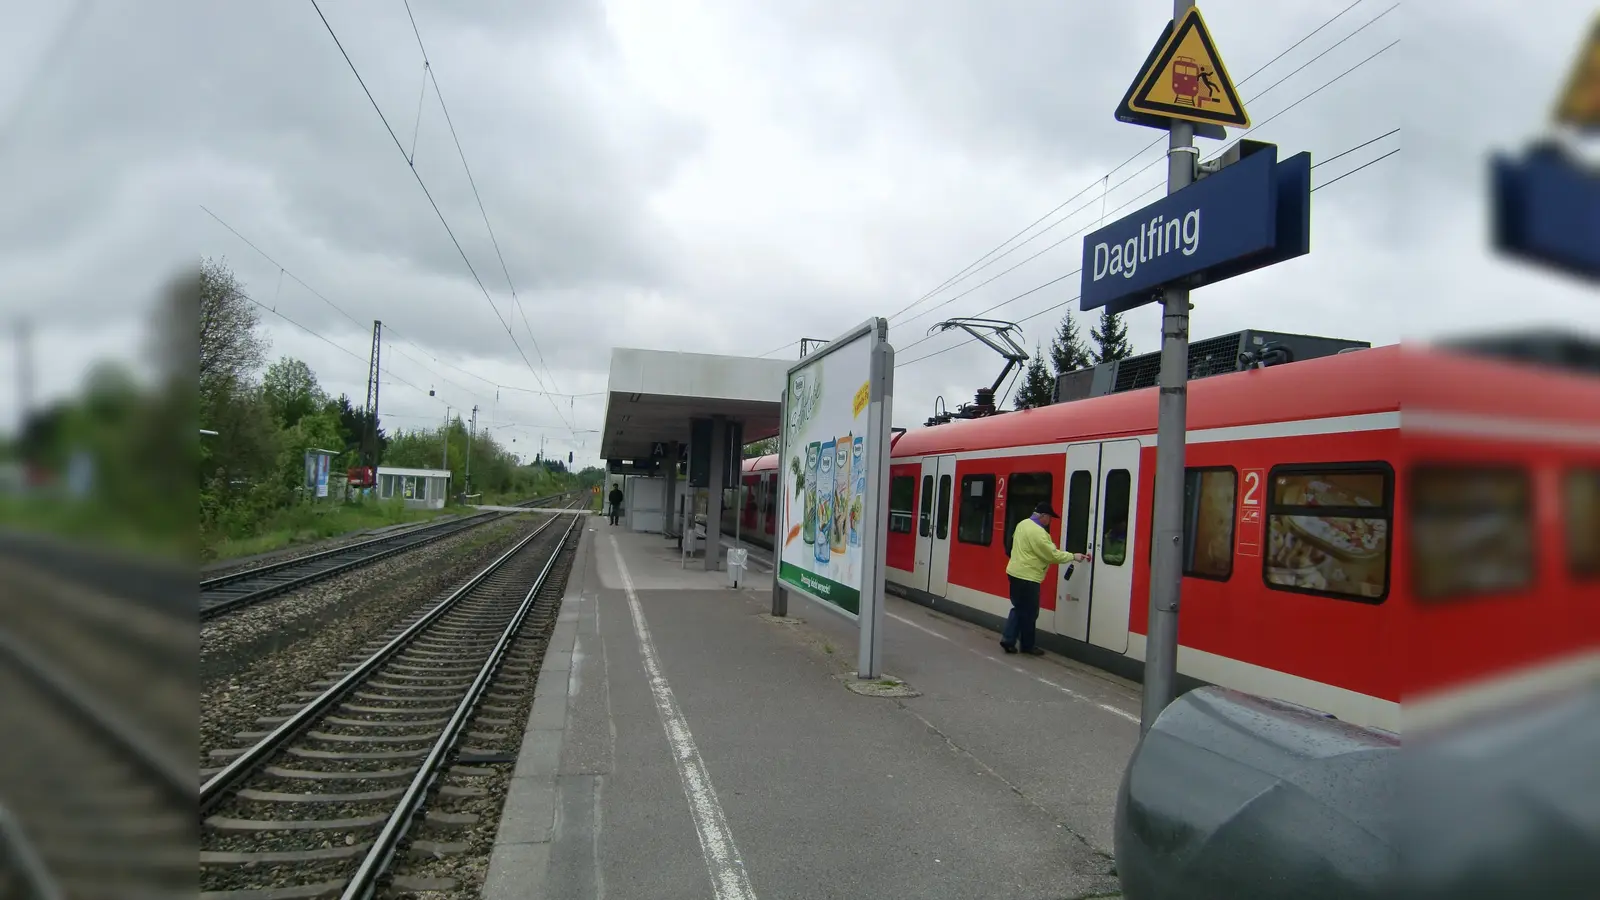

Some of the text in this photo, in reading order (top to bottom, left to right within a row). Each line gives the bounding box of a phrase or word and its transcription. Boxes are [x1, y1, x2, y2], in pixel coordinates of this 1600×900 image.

[1093, 208, 1200, 282] Daglfing
[654, 442, 663, 455] A
[997, 477, 1005, 498] 2
[1243, 471, 1260, 505] 2
